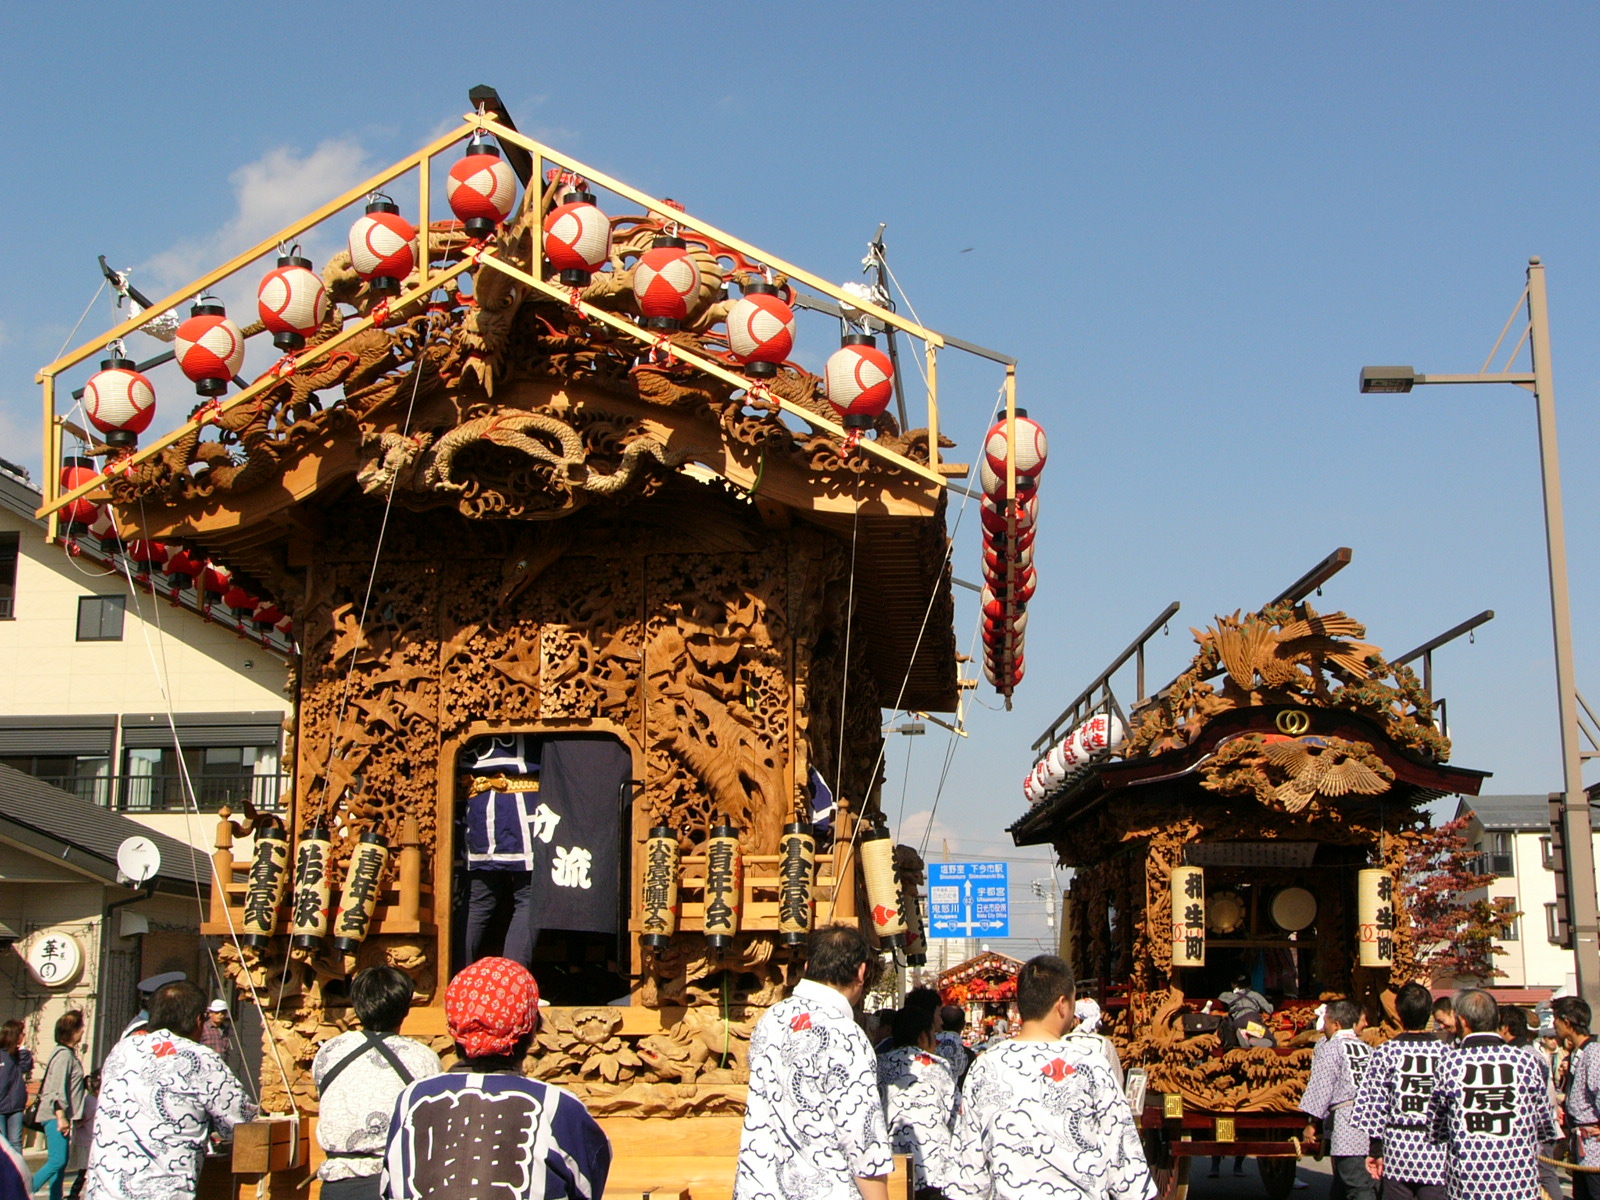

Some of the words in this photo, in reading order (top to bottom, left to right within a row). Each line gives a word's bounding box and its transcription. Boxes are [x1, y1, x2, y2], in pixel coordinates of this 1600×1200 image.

[340, 848, 383, 935] 青年会
[706, 840, 734, 929] 青年会
[1462, 1063, 1516, 1136] 川原町
